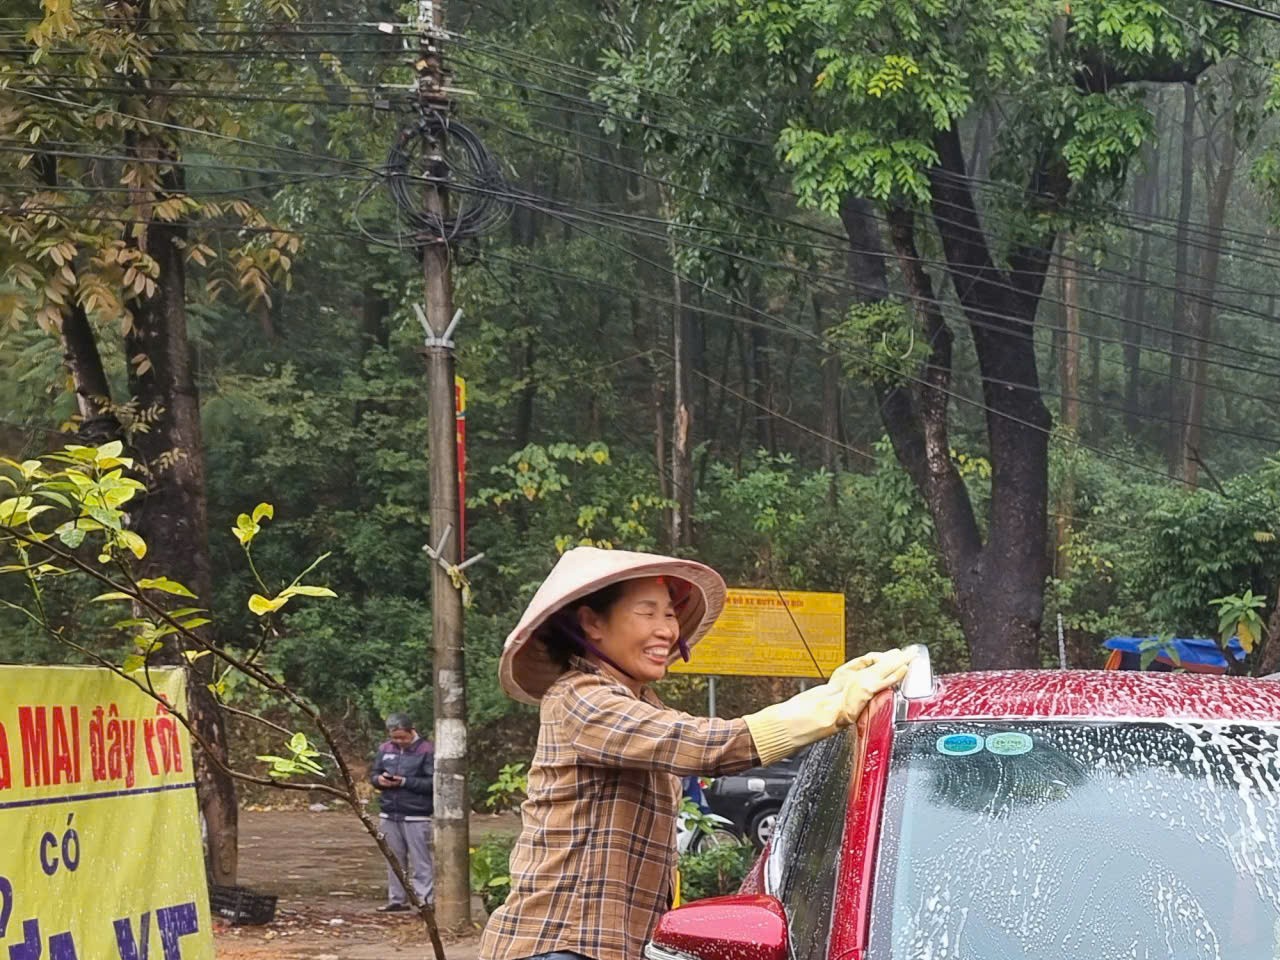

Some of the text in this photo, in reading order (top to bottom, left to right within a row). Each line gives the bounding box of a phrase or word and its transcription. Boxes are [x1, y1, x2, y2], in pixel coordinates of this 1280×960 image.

[18, 706, 81, 787] MAI
[89, 703, 136, 788] đây
[40, 813, 80, 876] có
